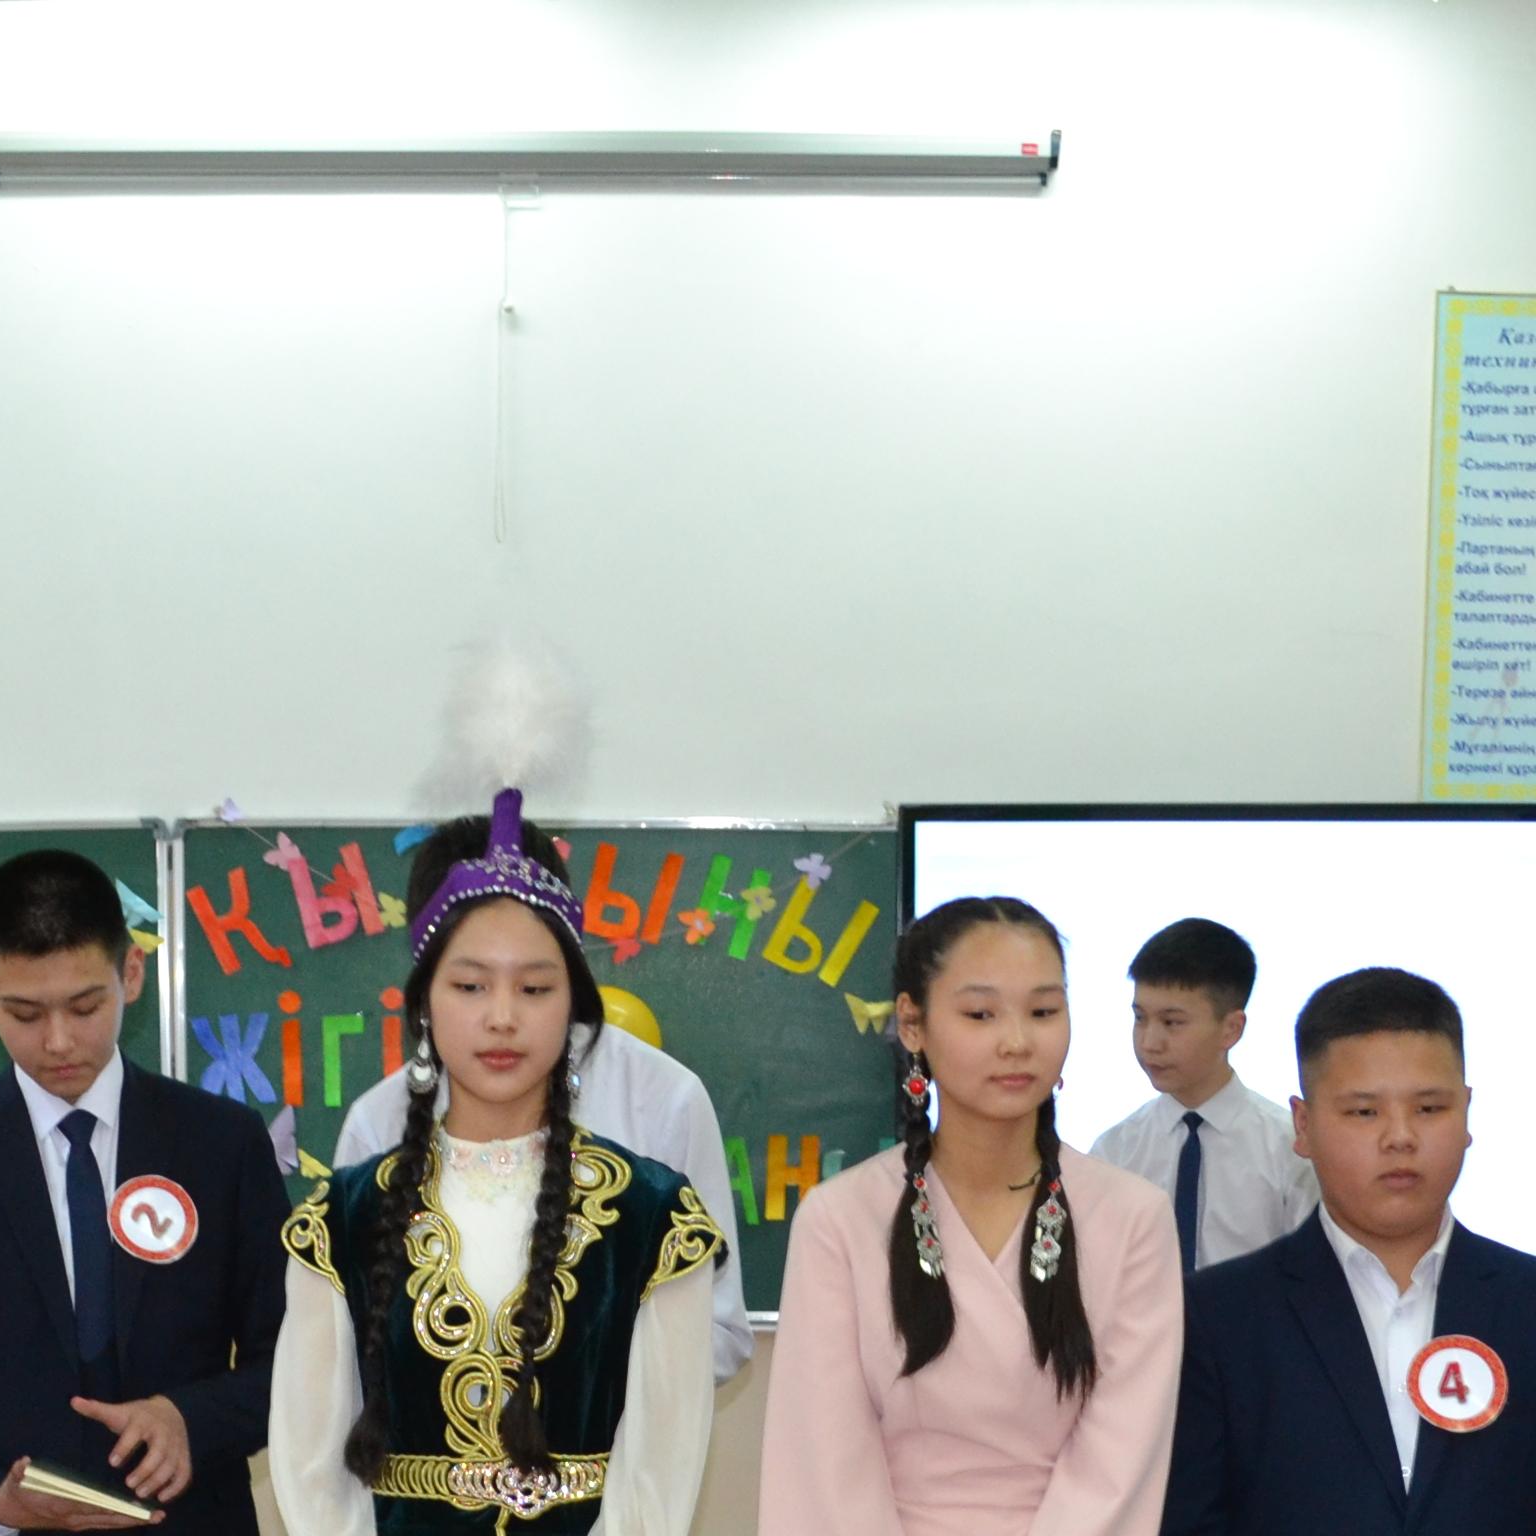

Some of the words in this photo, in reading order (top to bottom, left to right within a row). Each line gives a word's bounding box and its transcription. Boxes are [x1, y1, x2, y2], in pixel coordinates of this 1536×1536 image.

[185, 824, 435, 976] ҚЫ
[553, 837, 880, 988] ЫНЫ
[191, 986, 405, 1108] ЖІГІ
[131, 1203, 173, 1240] 2
[1438, 1361, 1470, 1404] 4
